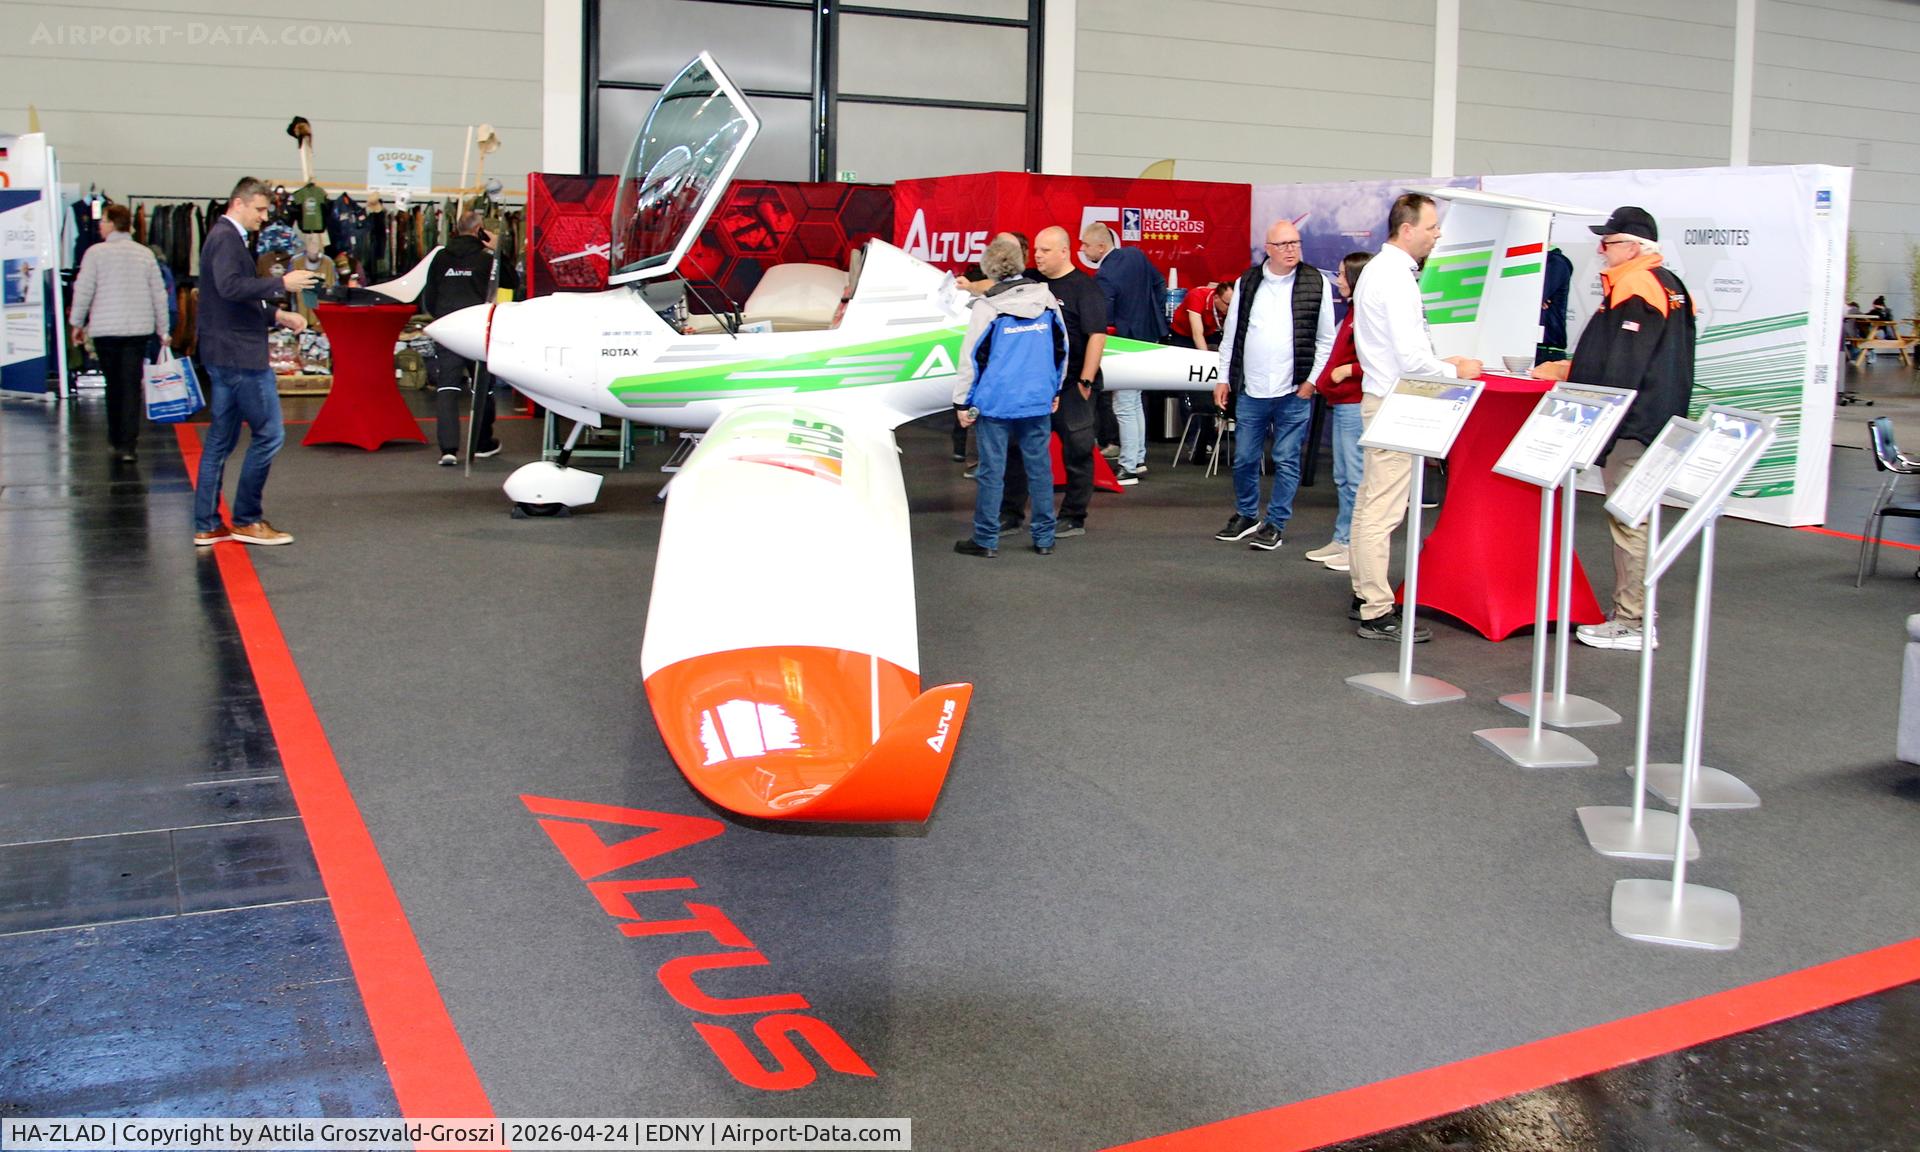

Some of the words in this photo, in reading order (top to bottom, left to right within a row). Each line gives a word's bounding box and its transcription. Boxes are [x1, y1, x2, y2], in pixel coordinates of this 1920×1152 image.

[1143, 208, 1189, 221] WORLD
[1143, 221, 1204, 232] RECORDS
[1685, 229, 1749, 246] COMPOSITES
[601, 348, 639, 357] ROTAX
